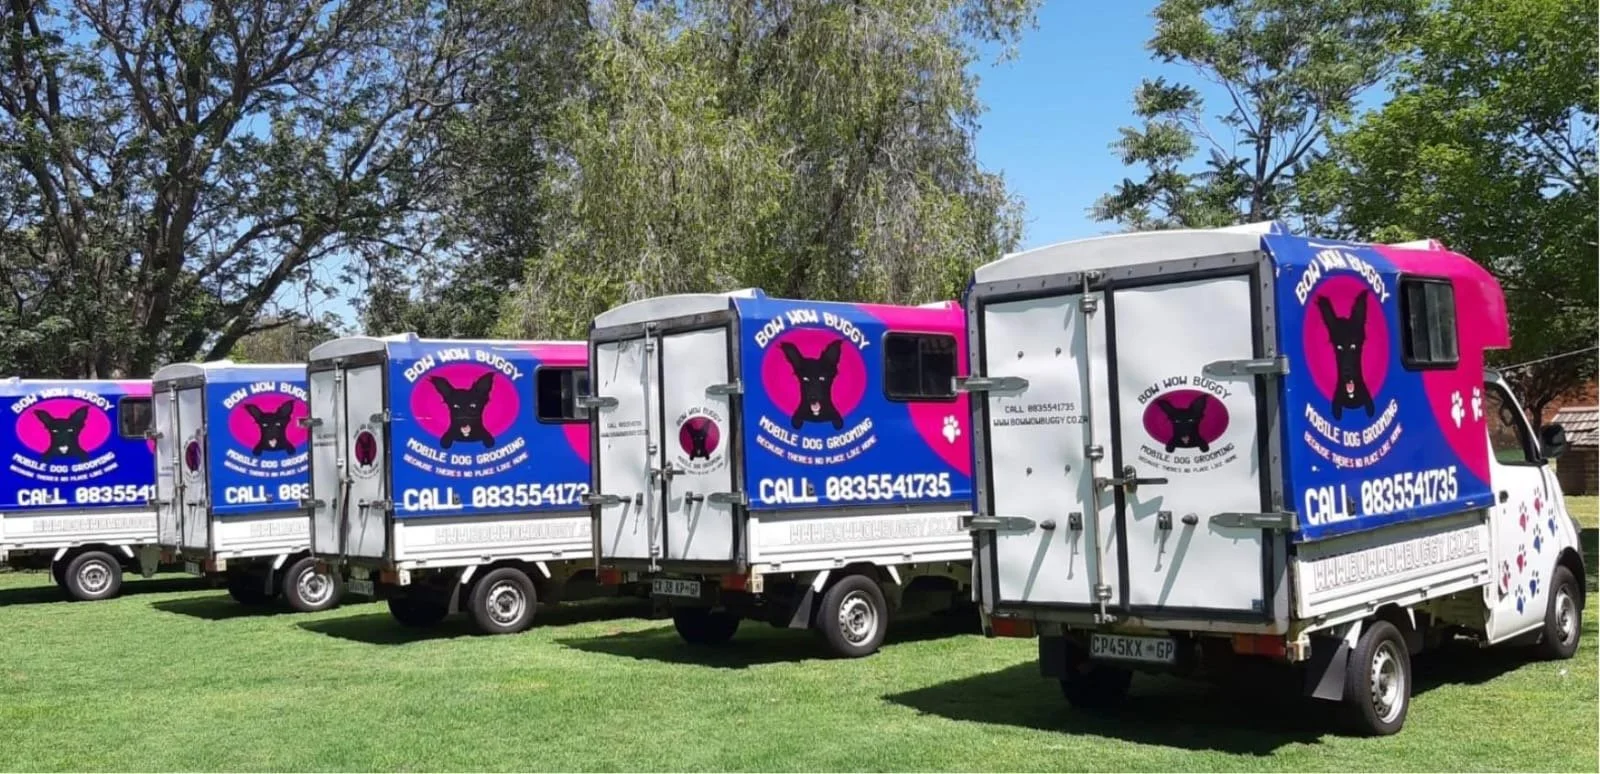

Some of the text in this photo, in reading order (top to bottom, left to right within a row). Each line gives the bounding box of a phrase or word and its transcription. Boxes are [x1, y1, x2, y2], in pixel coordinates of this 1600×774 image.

[1295, 250, 1390, 305] BOW WOW BUGGY
[754, 309, 870, 350] BOW WOW BUGGY
[404, 348, 523, 382] BOW WOW BUGGY
[11, 394, 38, 414] BOW
[73, 388, 115, 412] BUGGY
[223, 388, 248, 409] BOW
[250, 381, 276, 393] WOW
[1137, 376, 1232, 405] BOW WOW BUGGY
[1005, 405, 1024, 414] CALL
[1305, 398, 1398, 447] MOBILE DOG GROOMING
[759, 415, 873, 450] MOBILE DOG GROOMING
[226, 448, 258, 467] MOBILE
[260, 460, 278, 468] DOG
[407, 437, 525, 465] MOBILE DOG GROOMING
[1141, 443, 1235, 464] MOBILE DOG GROOMING
[50, 464, 69, 473] DOG
[17, 484, 156, 506] CALL 0835541
[225, 485, 267, 503] CALL
[403, 487, 463, 511] CALL
[759, 473, 951, 504] CALL 0835541735
[1305, 465, 1458, 525] CALL 0835541735
[1156, 641, 1173, 659] GP
